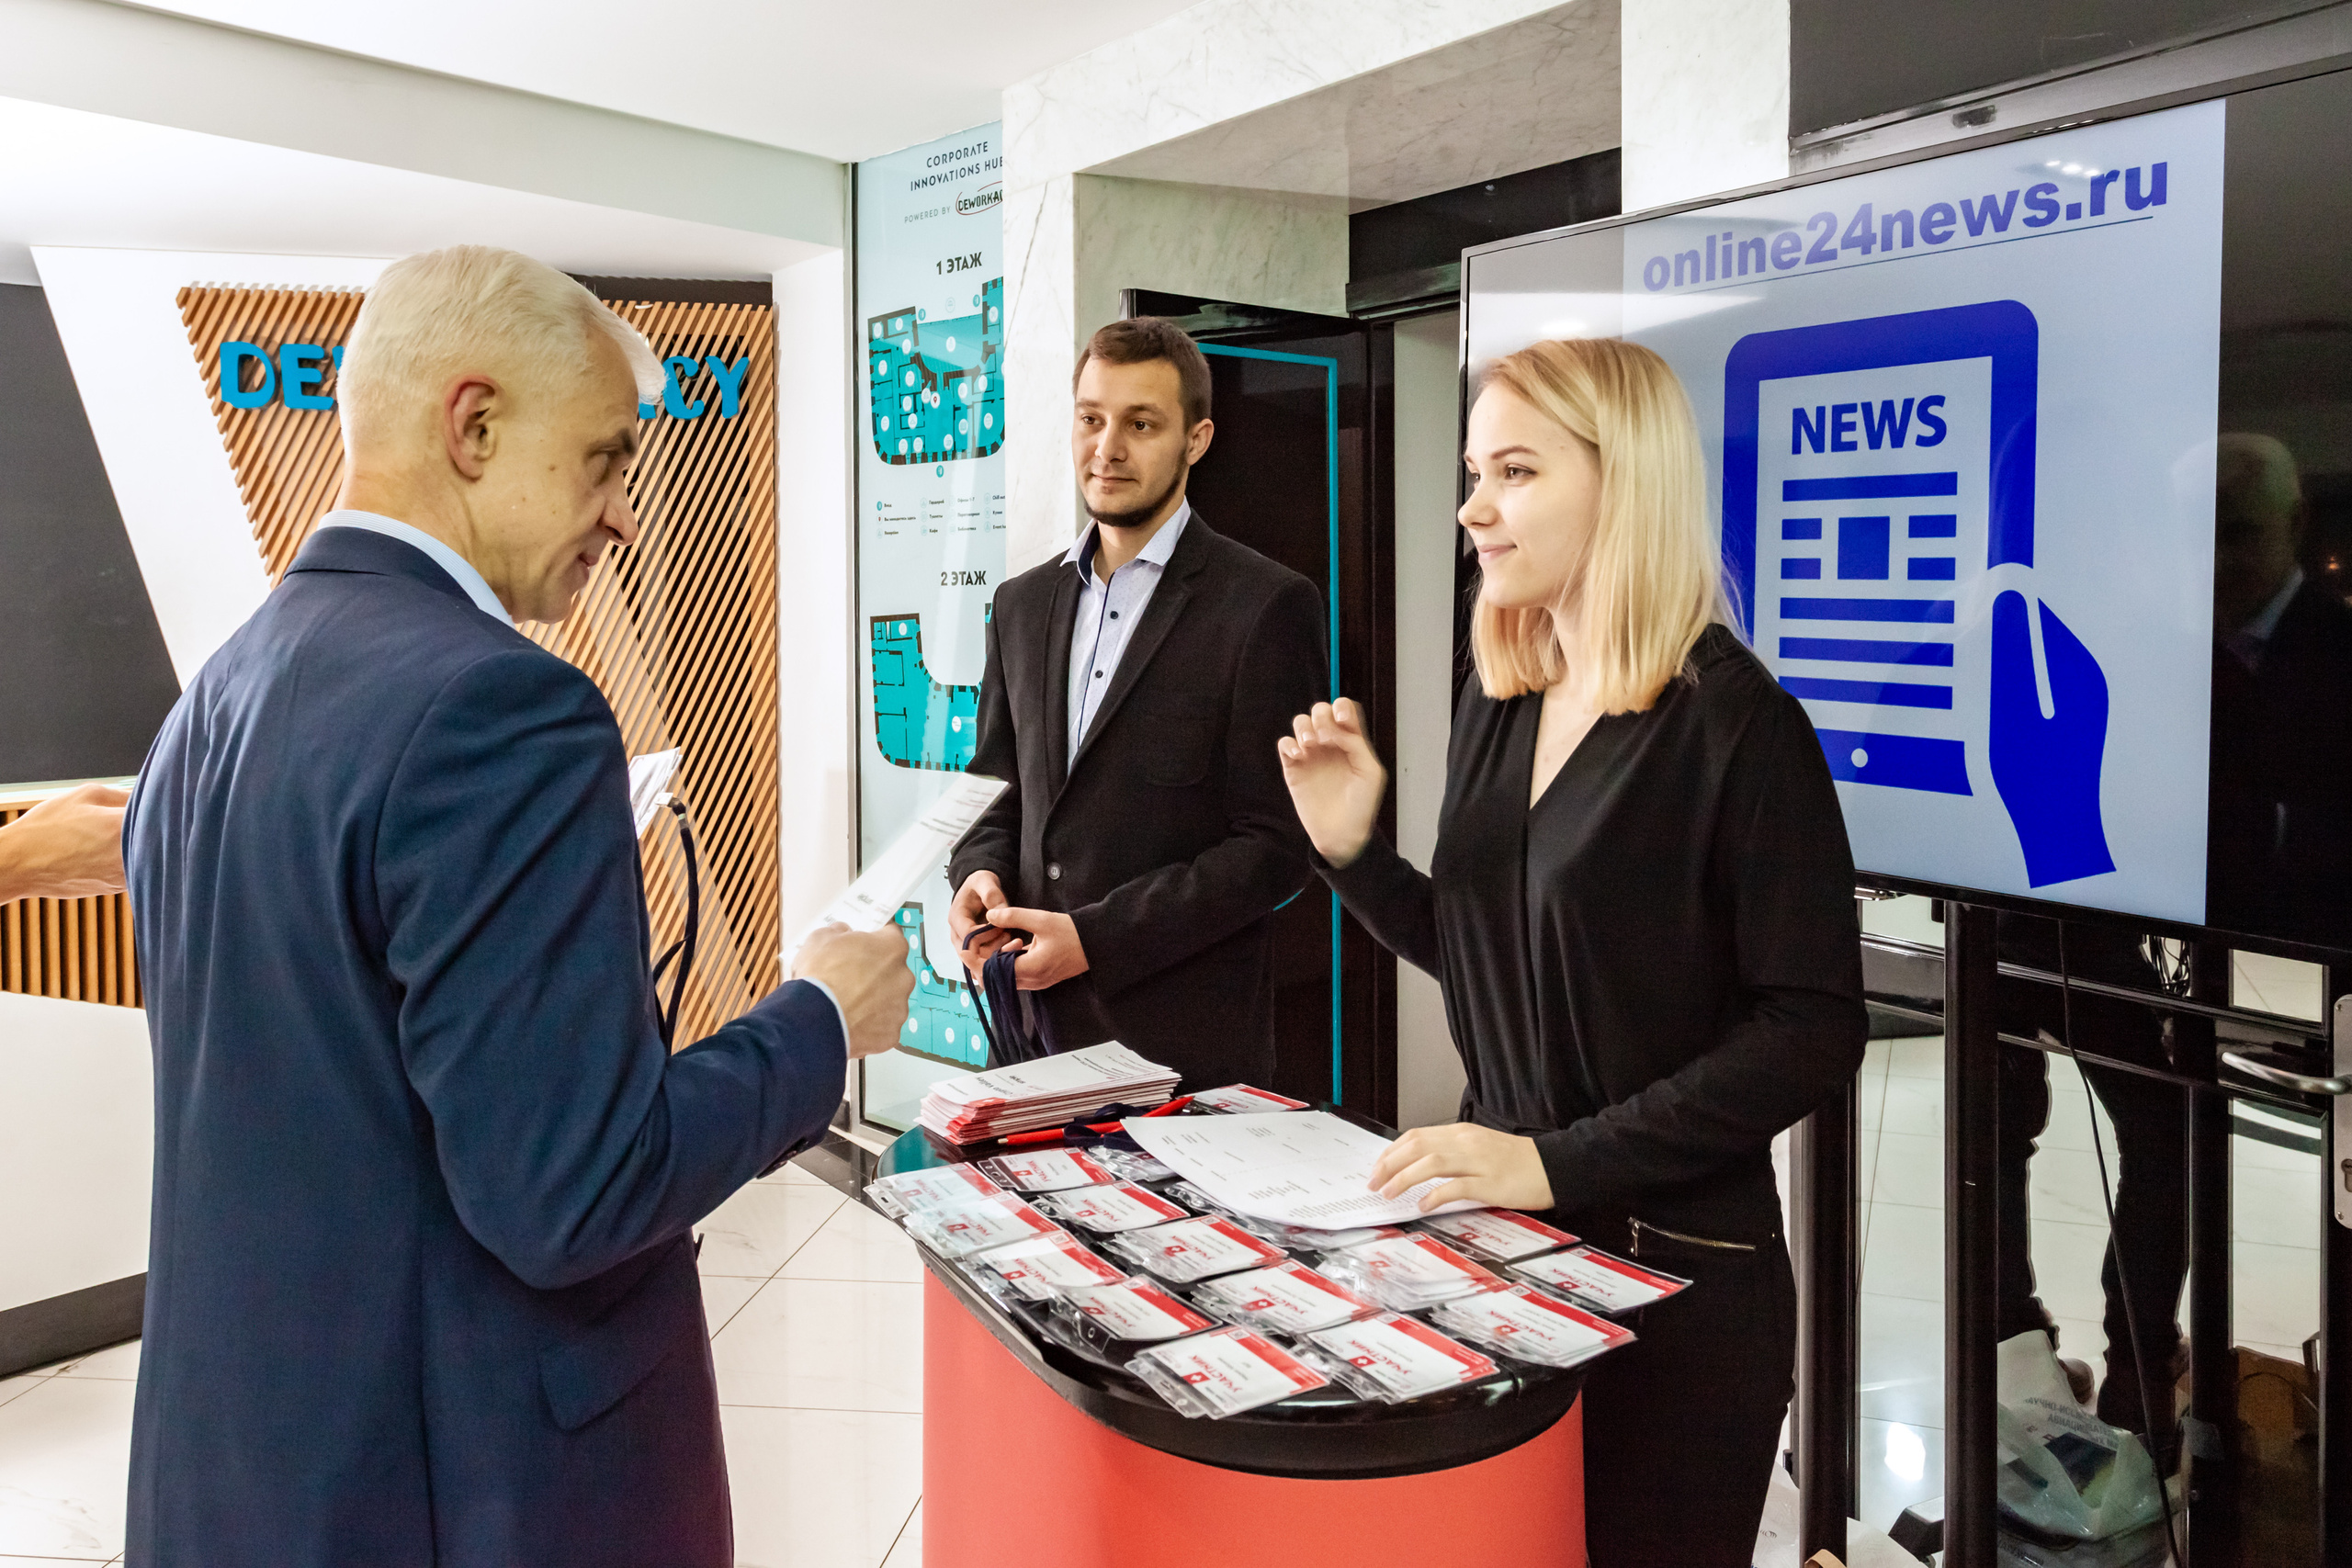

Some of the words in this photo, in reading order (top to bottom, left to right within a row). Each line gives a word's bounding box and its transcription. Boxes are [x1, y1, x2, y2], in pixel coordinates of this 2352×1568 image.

[926, 141, 989, 168] CORPORATE
[910, 163, 980, 191] INNOVATIONS
[904, 208, 939, 223] POWERED
[942, 206, 951, 215] BY
[1644, 161, 2168, 293] online24news.ru
[936, 261, 942, 275] 1
[946, 252, 982, 274] ЭТАЖ
[1791, 394, 1948, 456] NEWS
[941, 571, 948, 586] 2
[951, 570, 987, 586] ЭТАЖ
[1350, 1340, 1413, 1375] УЧАСТНИК
[1187, 1354, 1244, 1393] УЧАСТНИК
